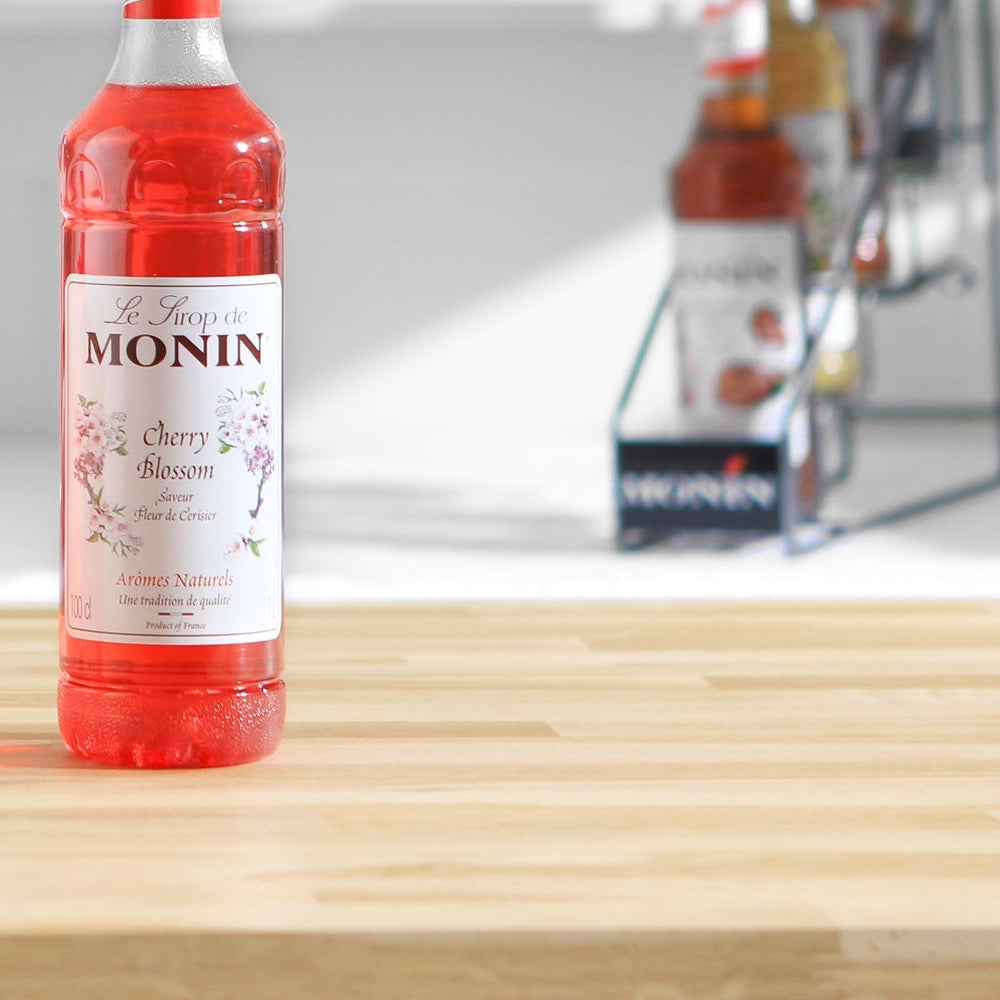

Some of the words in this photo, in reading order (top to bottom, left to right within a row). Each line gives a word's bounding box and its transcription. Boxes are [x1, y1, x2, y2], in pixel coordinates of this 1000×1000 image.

[104, 295, 143, 325] Le
[148, 295, 217, 333] Sirop
[224, 307, 248, 326] de
[85, 332, 264, 368] MONIN
[143, 420, 209, 454] Cherry
[136, 453, 214, 480] Blossom
[155, 488, 194, 506] Saveur
[133, 506, 164, 523] Fleur
[165, 508, 177, 521] de
[179, 507, 217, 522] Cerisier
[116, 571, 170, 588] Arômes
[174, 569, 234, 588] Naturels
[119, 594, 138, 606] Une
[140, 594, 184, 606] tradition
[186, 594, 196, 606] de
[199, 594, 231, 610] qualité
[145, 621, 172, 631] Product
[173, 621, 182, 632] of
[183, 621, 207, 631] France
